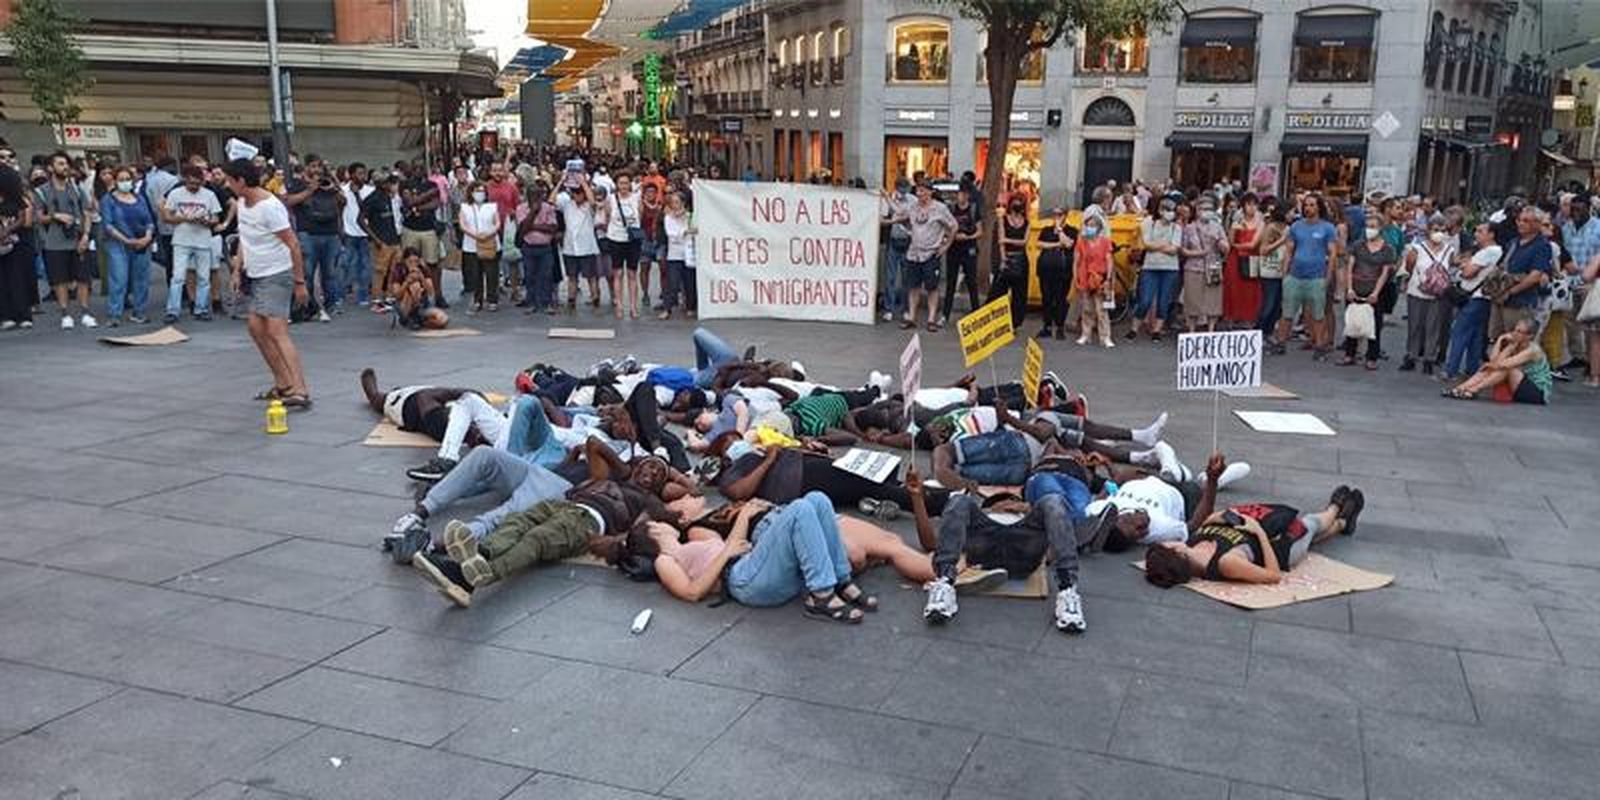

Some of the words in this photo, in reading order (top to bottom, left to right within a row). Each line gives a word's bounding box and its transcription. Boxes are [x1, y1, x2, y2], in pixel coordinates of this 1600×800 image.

[1288, 113, 1366, 128] RODILLA
[752, 197, 785, 223] NO
[795, 199, 811, 225] A
[821, 199, 850, 225] LAS
[711, 237, 769, 265] LEYES
[789, 238, 865, 267] CONTRA
[710, 279, 738, 304] LOS
[752, 278, 869, 307] INMIGRANTES
[1179, 334, 1257, 362] ¡DERECHOS
